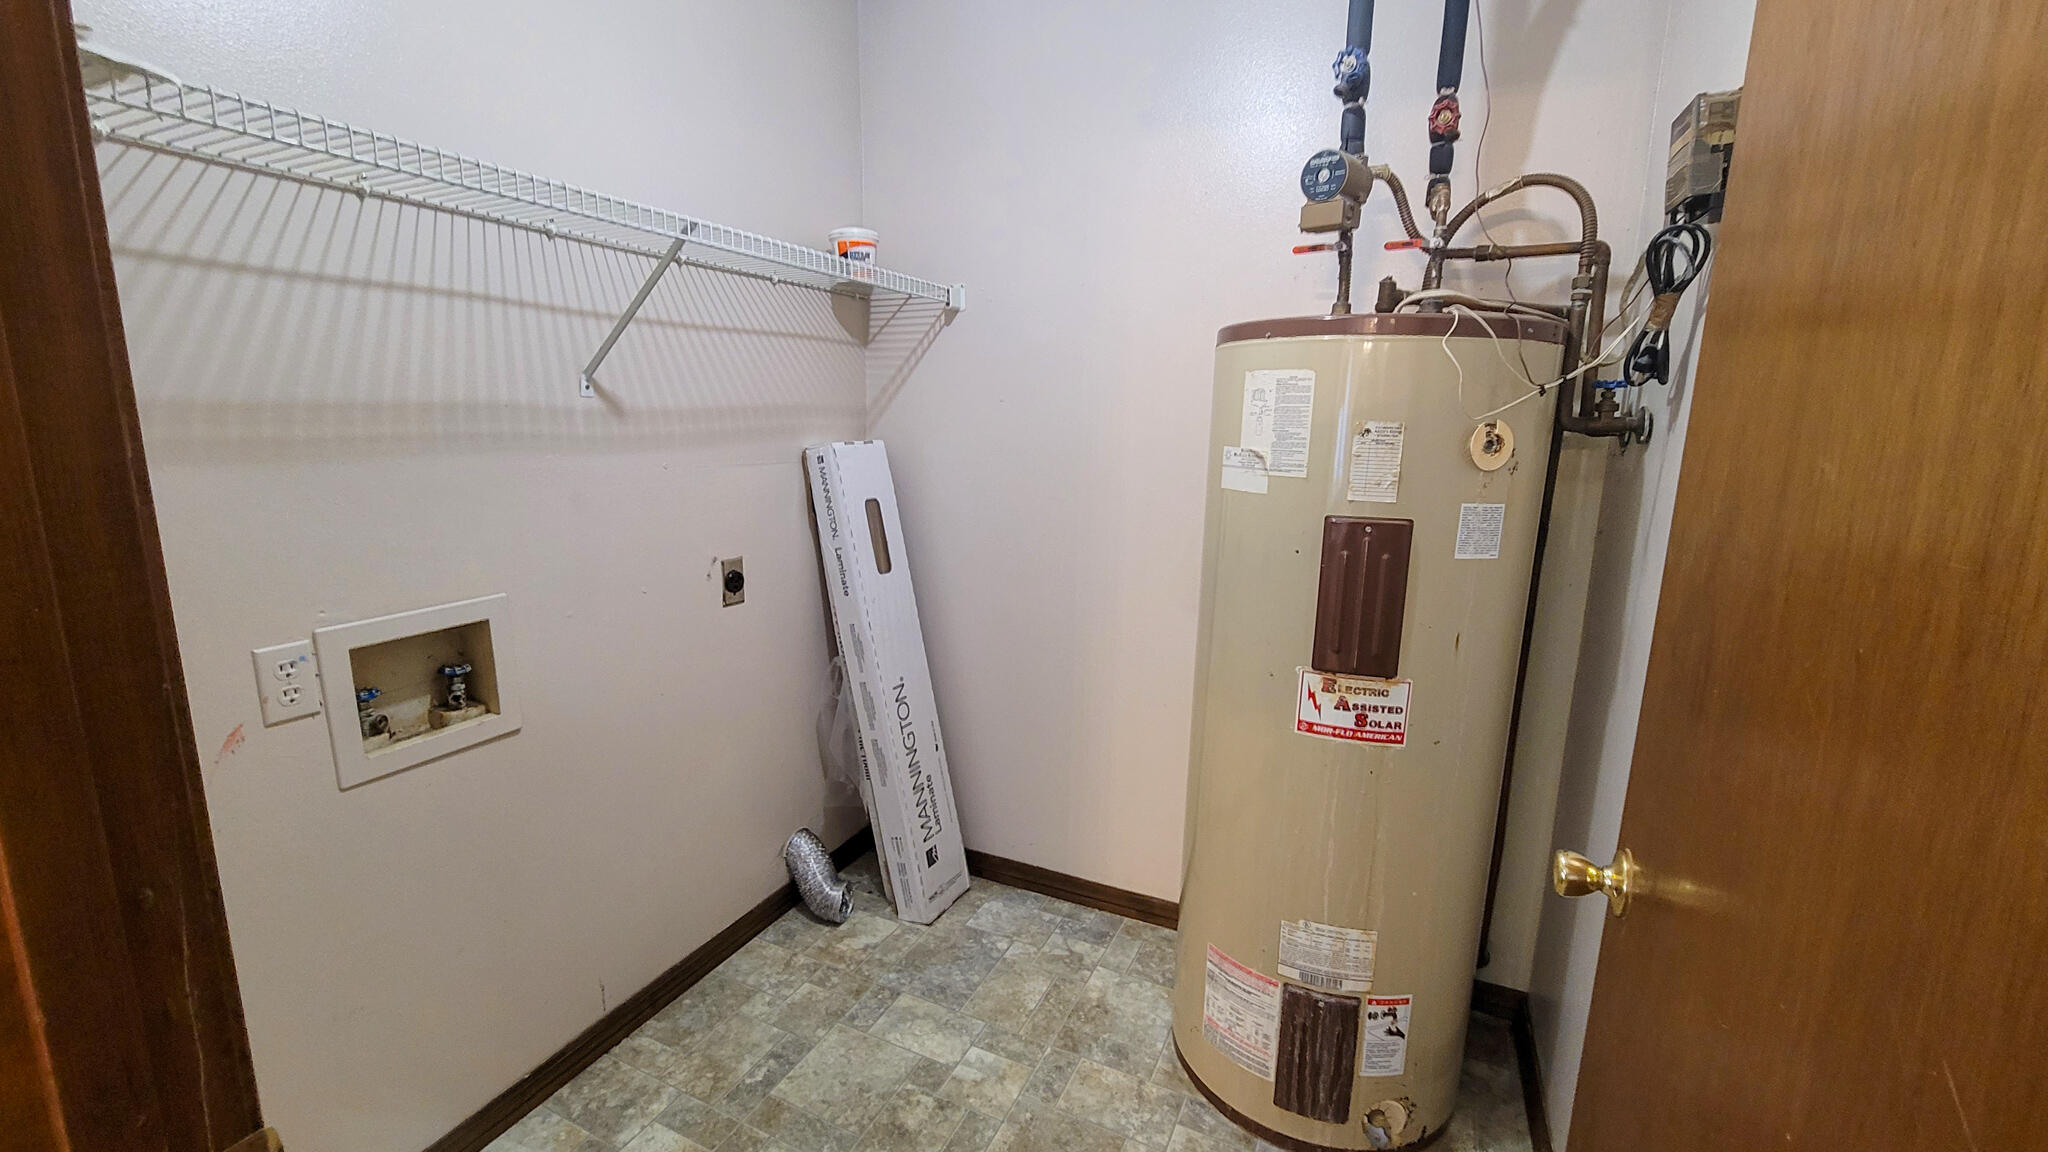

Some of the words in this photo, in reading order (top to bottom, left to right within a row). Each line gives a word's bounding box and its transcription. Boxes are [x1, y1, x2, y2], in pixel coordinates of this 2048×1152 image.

[834, 547, 849, 597] Laminate
[1321, 677, 1390, 698] ELECTRIC
[1334, 695, 1403, 715] ASSISTED
[1354, 713, 1402, 730] SOLAR
[1354, 730, 1403, 741] AMERICAN
[926, 774, 943, 836] Laminate
